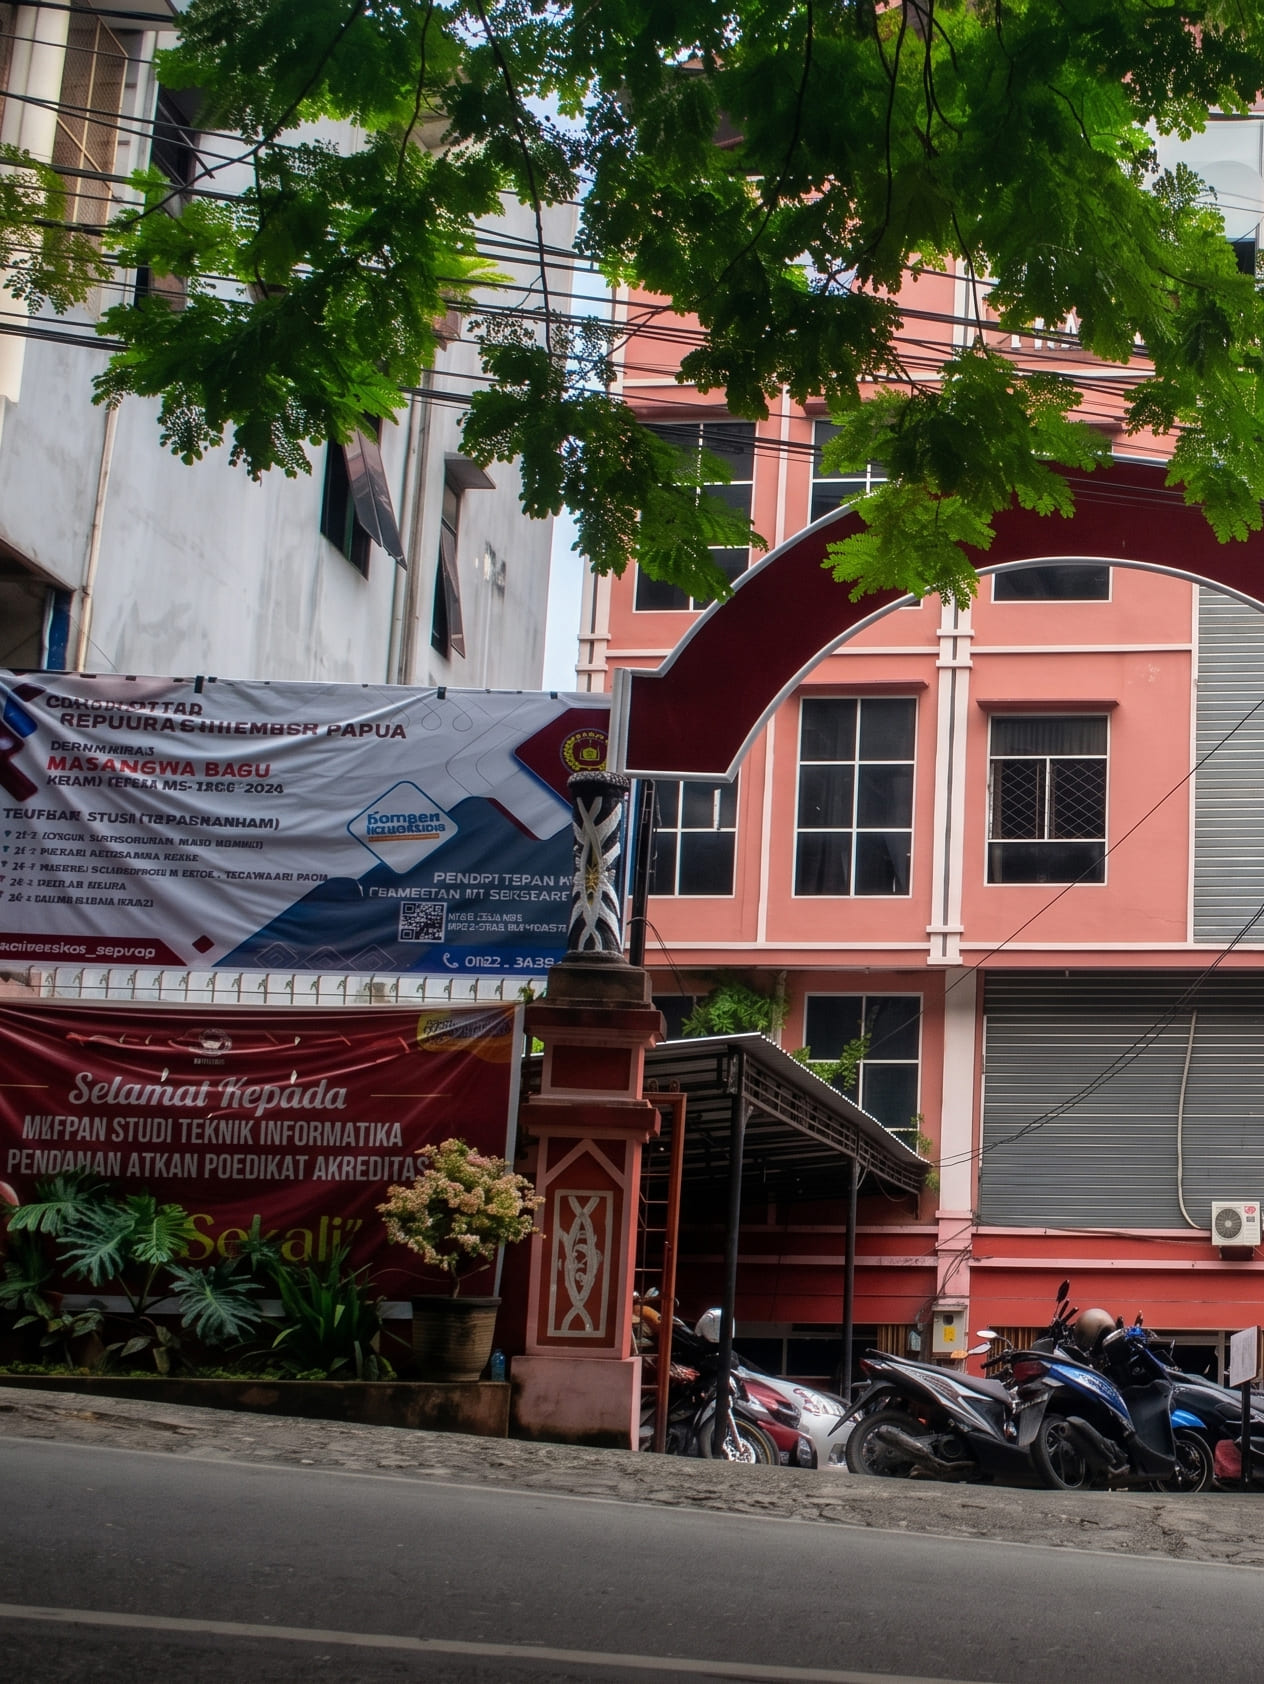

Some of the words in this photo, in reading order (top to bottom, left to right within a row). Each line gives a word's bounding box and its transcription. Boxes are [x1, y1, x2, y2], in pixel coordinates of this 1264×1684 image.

[326, 722, 407, 739] PAPUA
[46, 755, 196, 777] MASANGWA
[204, 761, 271, 779] BAGU
[68, 1071, 211, 1108] Selamat
[218, 1076, 348, 1118] Kepada
[111, 1117, 173, 1144] STUDI
[178, 1118, 255, 1145] TEKNIK
[260, 1120, 403, 1147] INFORMATIKA
[126, 1152, 198, 1178] ATKAN
[204, 1153, 308, 1180] POEDIKAT
